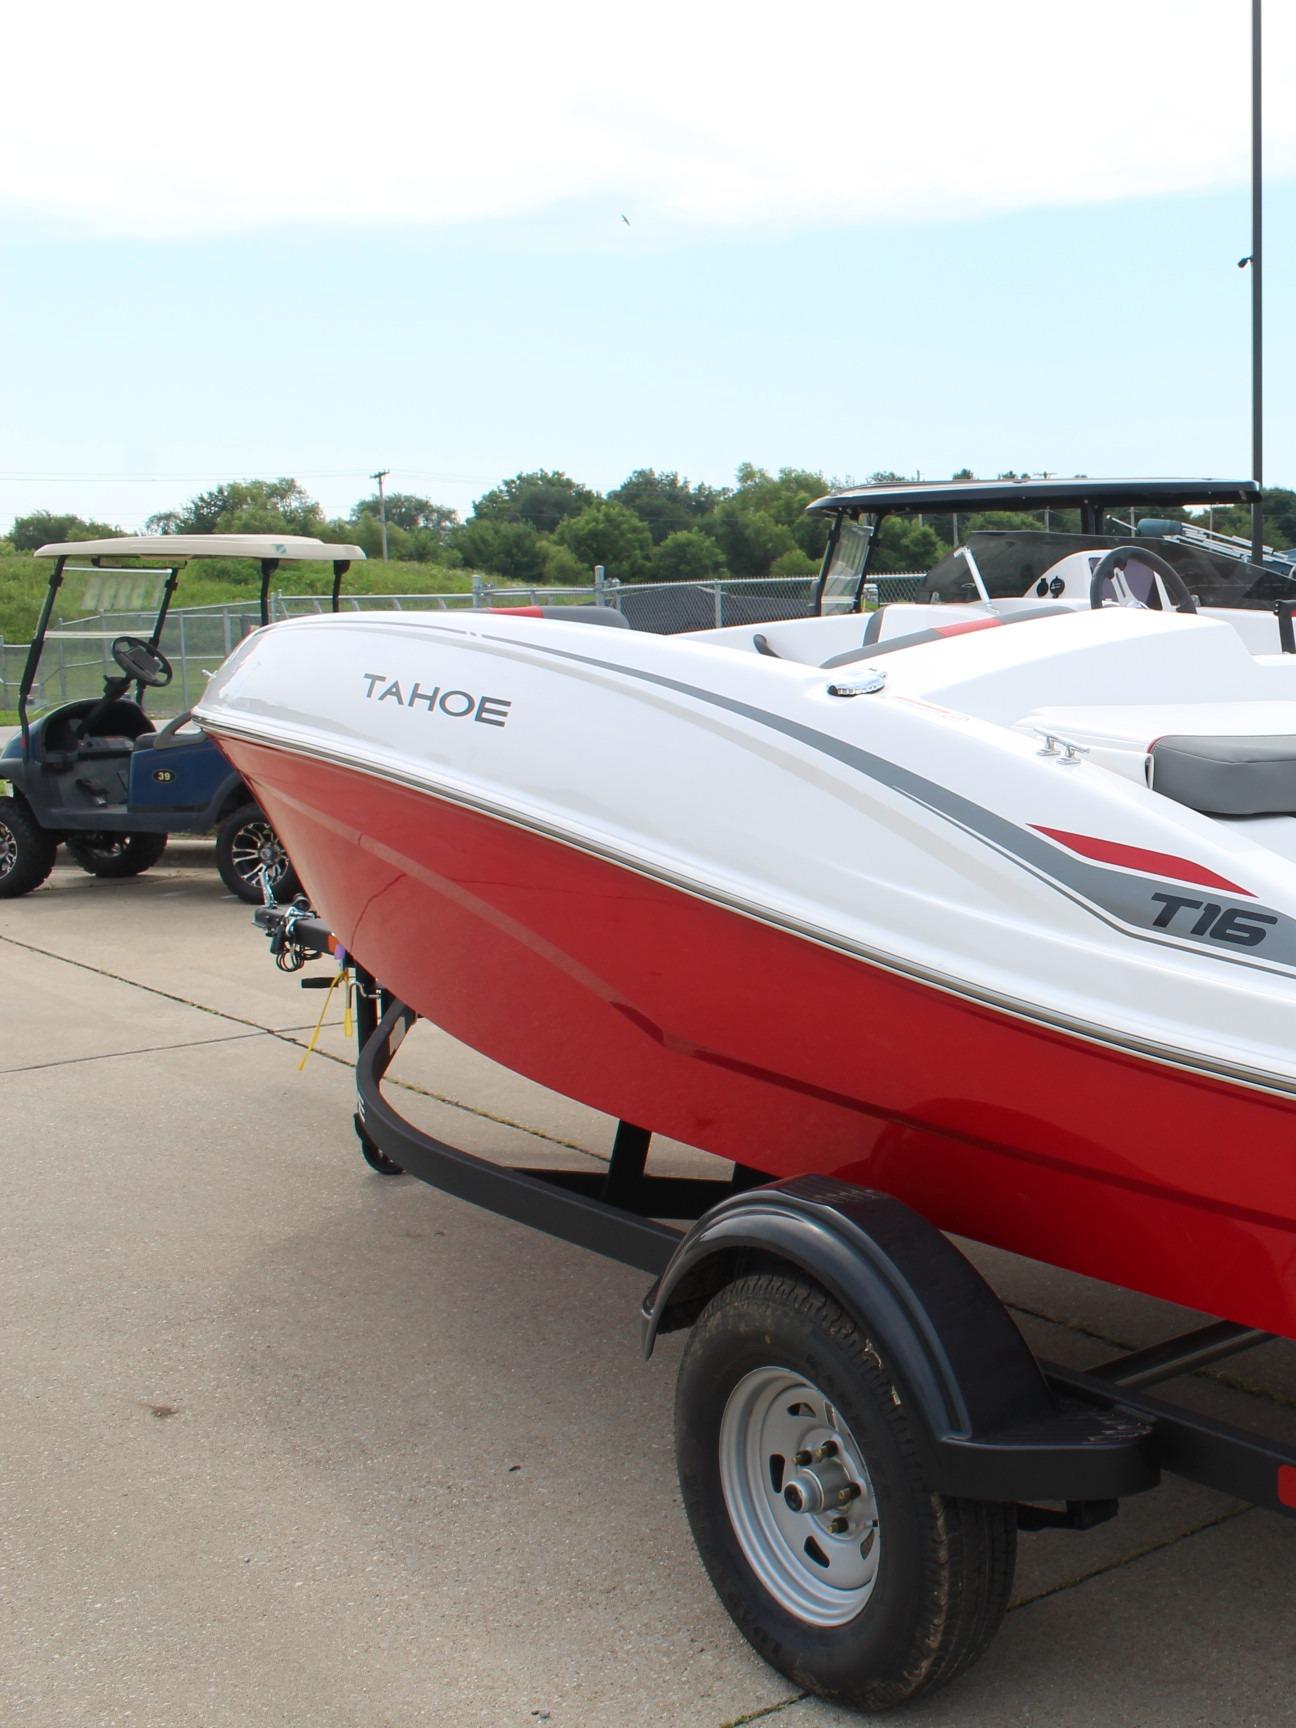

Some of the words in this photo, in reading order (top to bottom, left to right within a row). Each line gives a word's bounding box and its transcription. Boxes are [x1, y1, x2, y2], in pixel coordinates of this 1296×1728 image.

[363, 672, 513, 728] TAHOE
[157, 771, 171, 781] 39
[1151, 891, 1279, 947] T16
